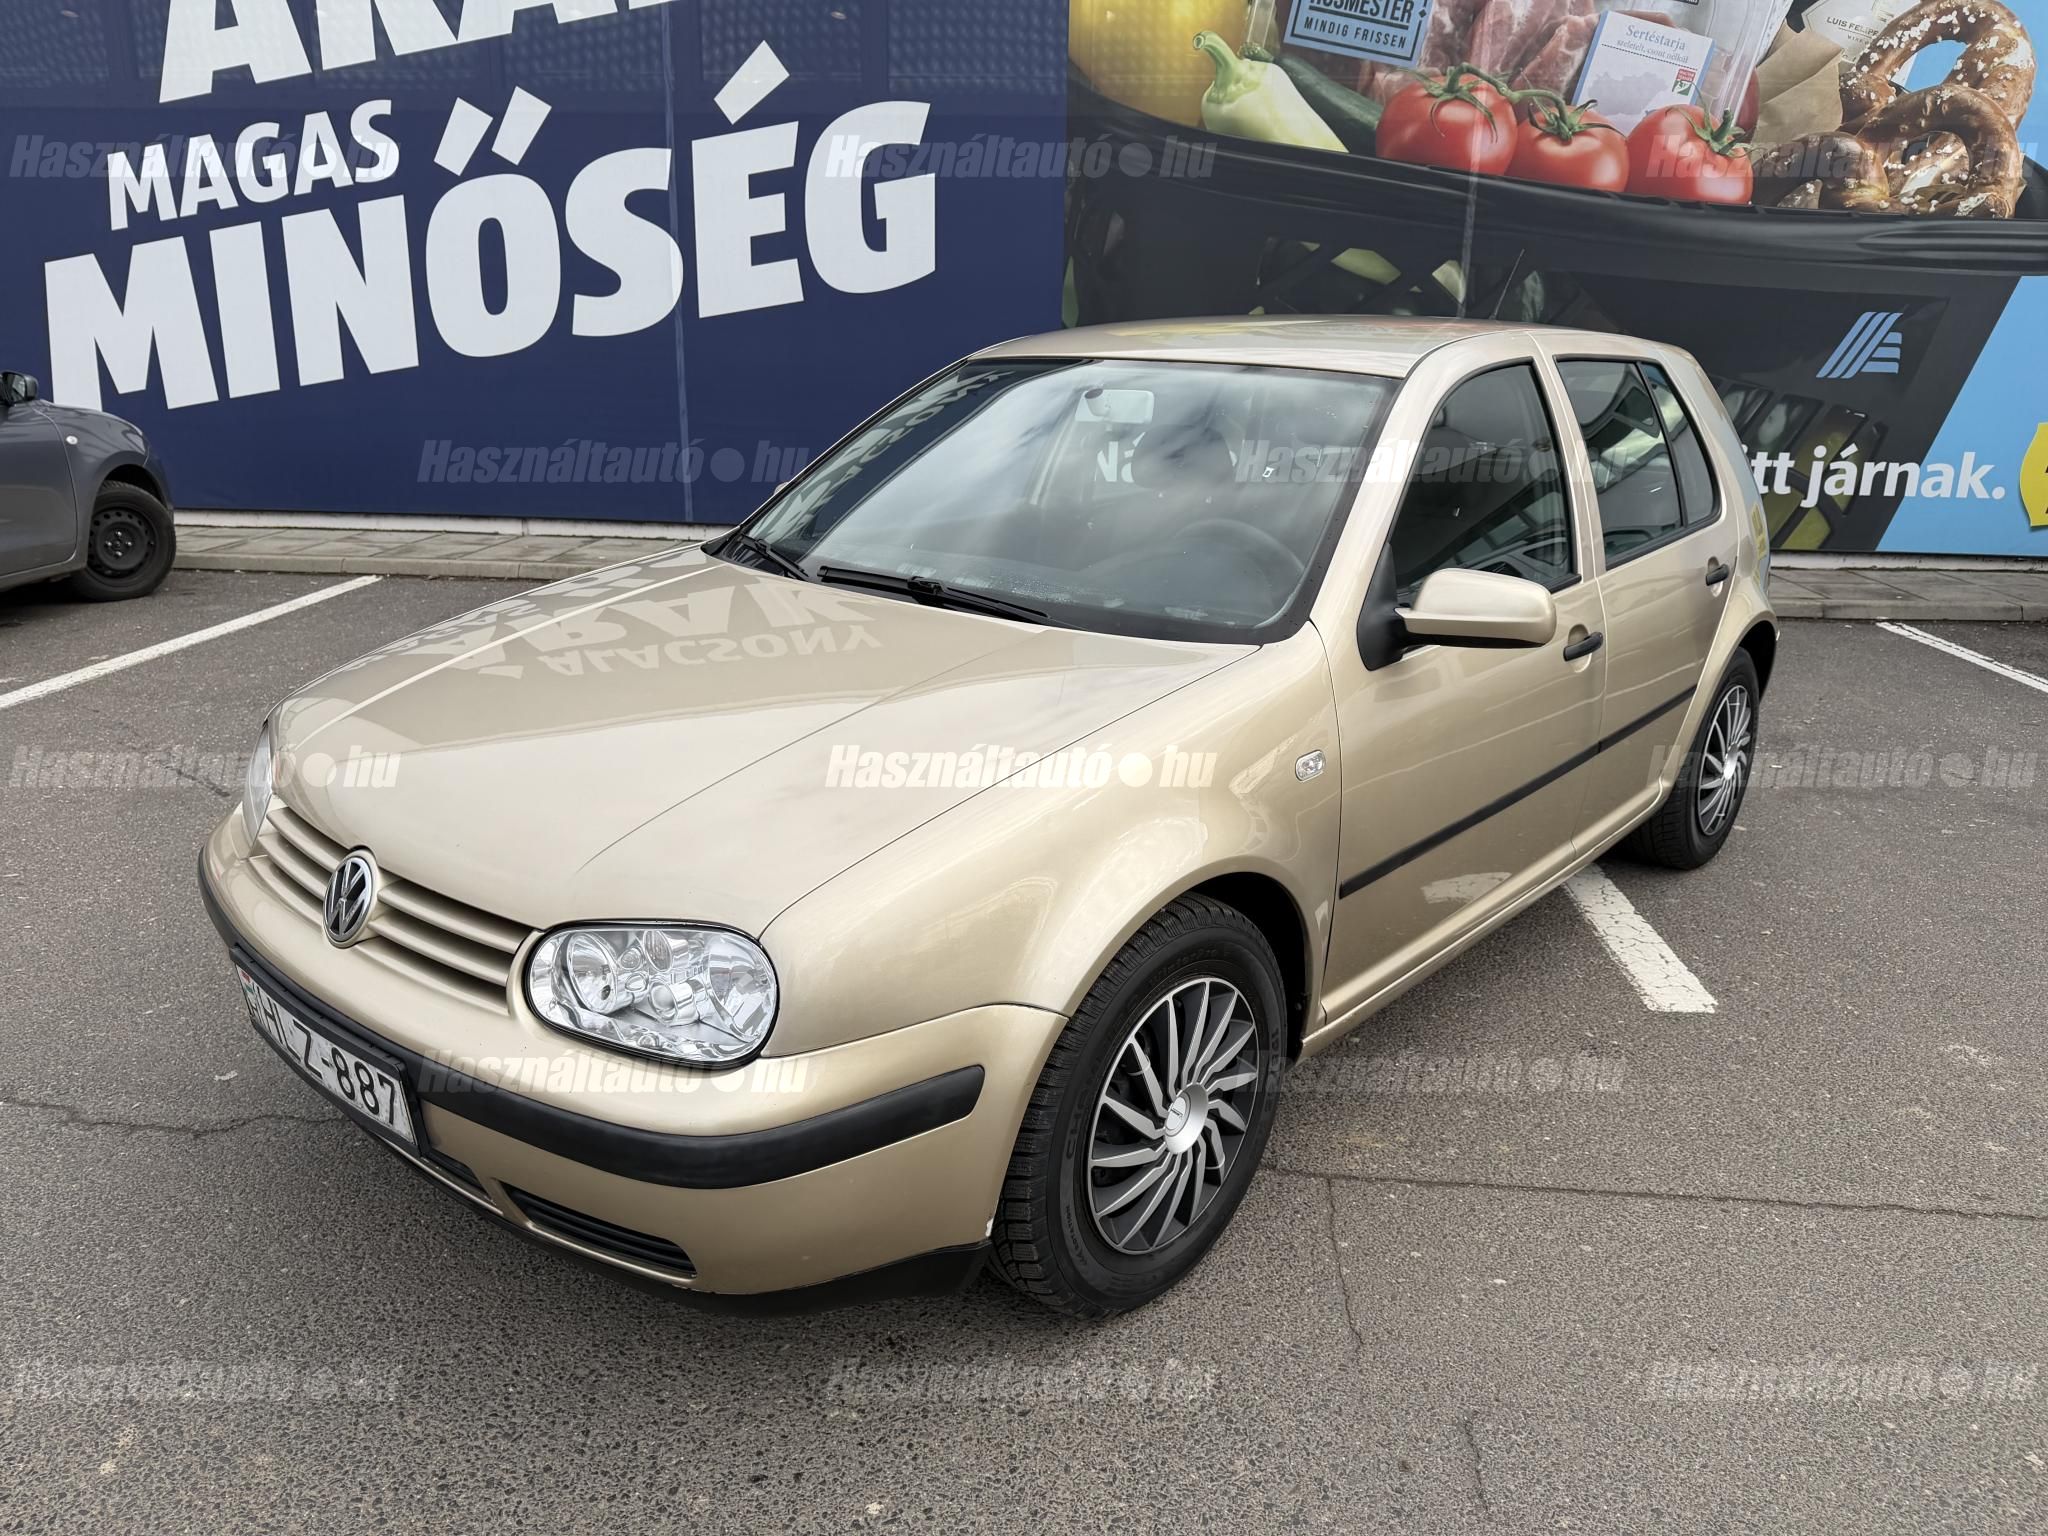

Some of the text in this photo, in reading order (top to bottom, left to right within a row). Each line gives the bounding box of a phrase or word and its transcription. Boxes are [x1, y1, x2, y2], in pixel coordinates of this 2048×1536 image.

[1303, 16, 1407, 49] MINDIG FRISSEN
[1625, 24, 1686, 52] Sertéstarja
[1826, 16, 1848, 28] LUIS
[107, 100, 400, 231] MAGAS
[44, 40, 936, 411] MINŐSÉG
[1800, 443, 2006, 508] járnak.
[256, 984, 395, 1125] HLZ-887
